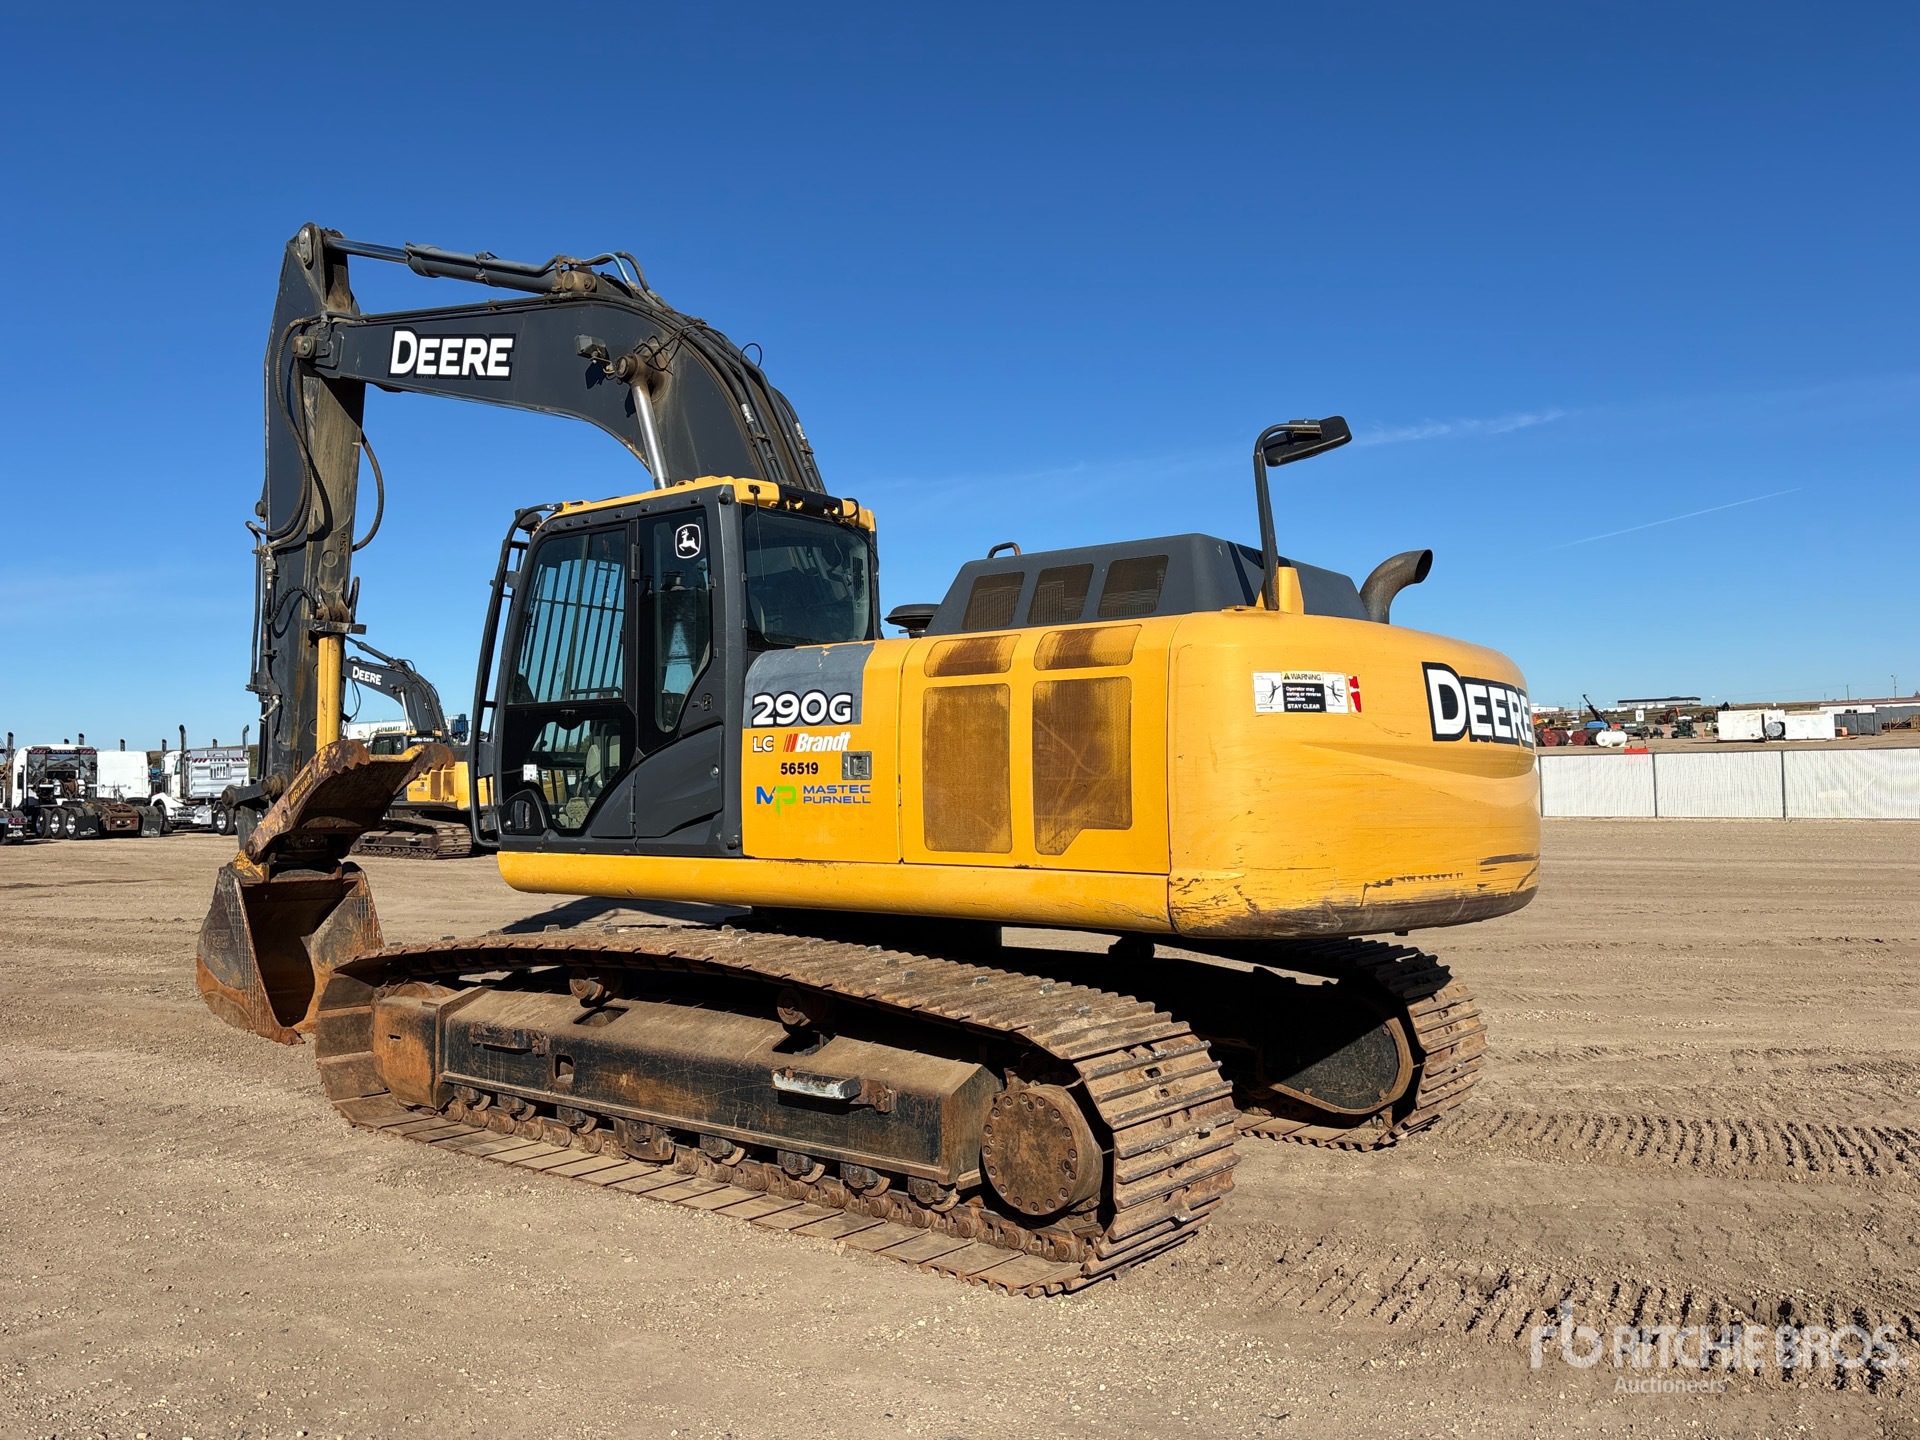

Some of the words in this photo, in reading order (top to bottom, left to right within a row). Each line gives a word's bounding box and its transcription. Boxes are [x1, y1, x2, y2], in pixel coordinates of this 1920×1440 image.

[388, 328, 514, 378] DEERE
[352, 665, 382, 686] DEERE
[1290, 673, 1321, 681] WARNING
[751, 689, 853, 727] 290G
[1424, 664, 1533, 744] DEERE
[752, 736, 774, 752] LC
[794, 731, 851, 753] Brandt
[780, 762, 819, 775] 56519
[803, 784, 871, 794] MASTEC
[803, 795, 871, 804] PURNELL
